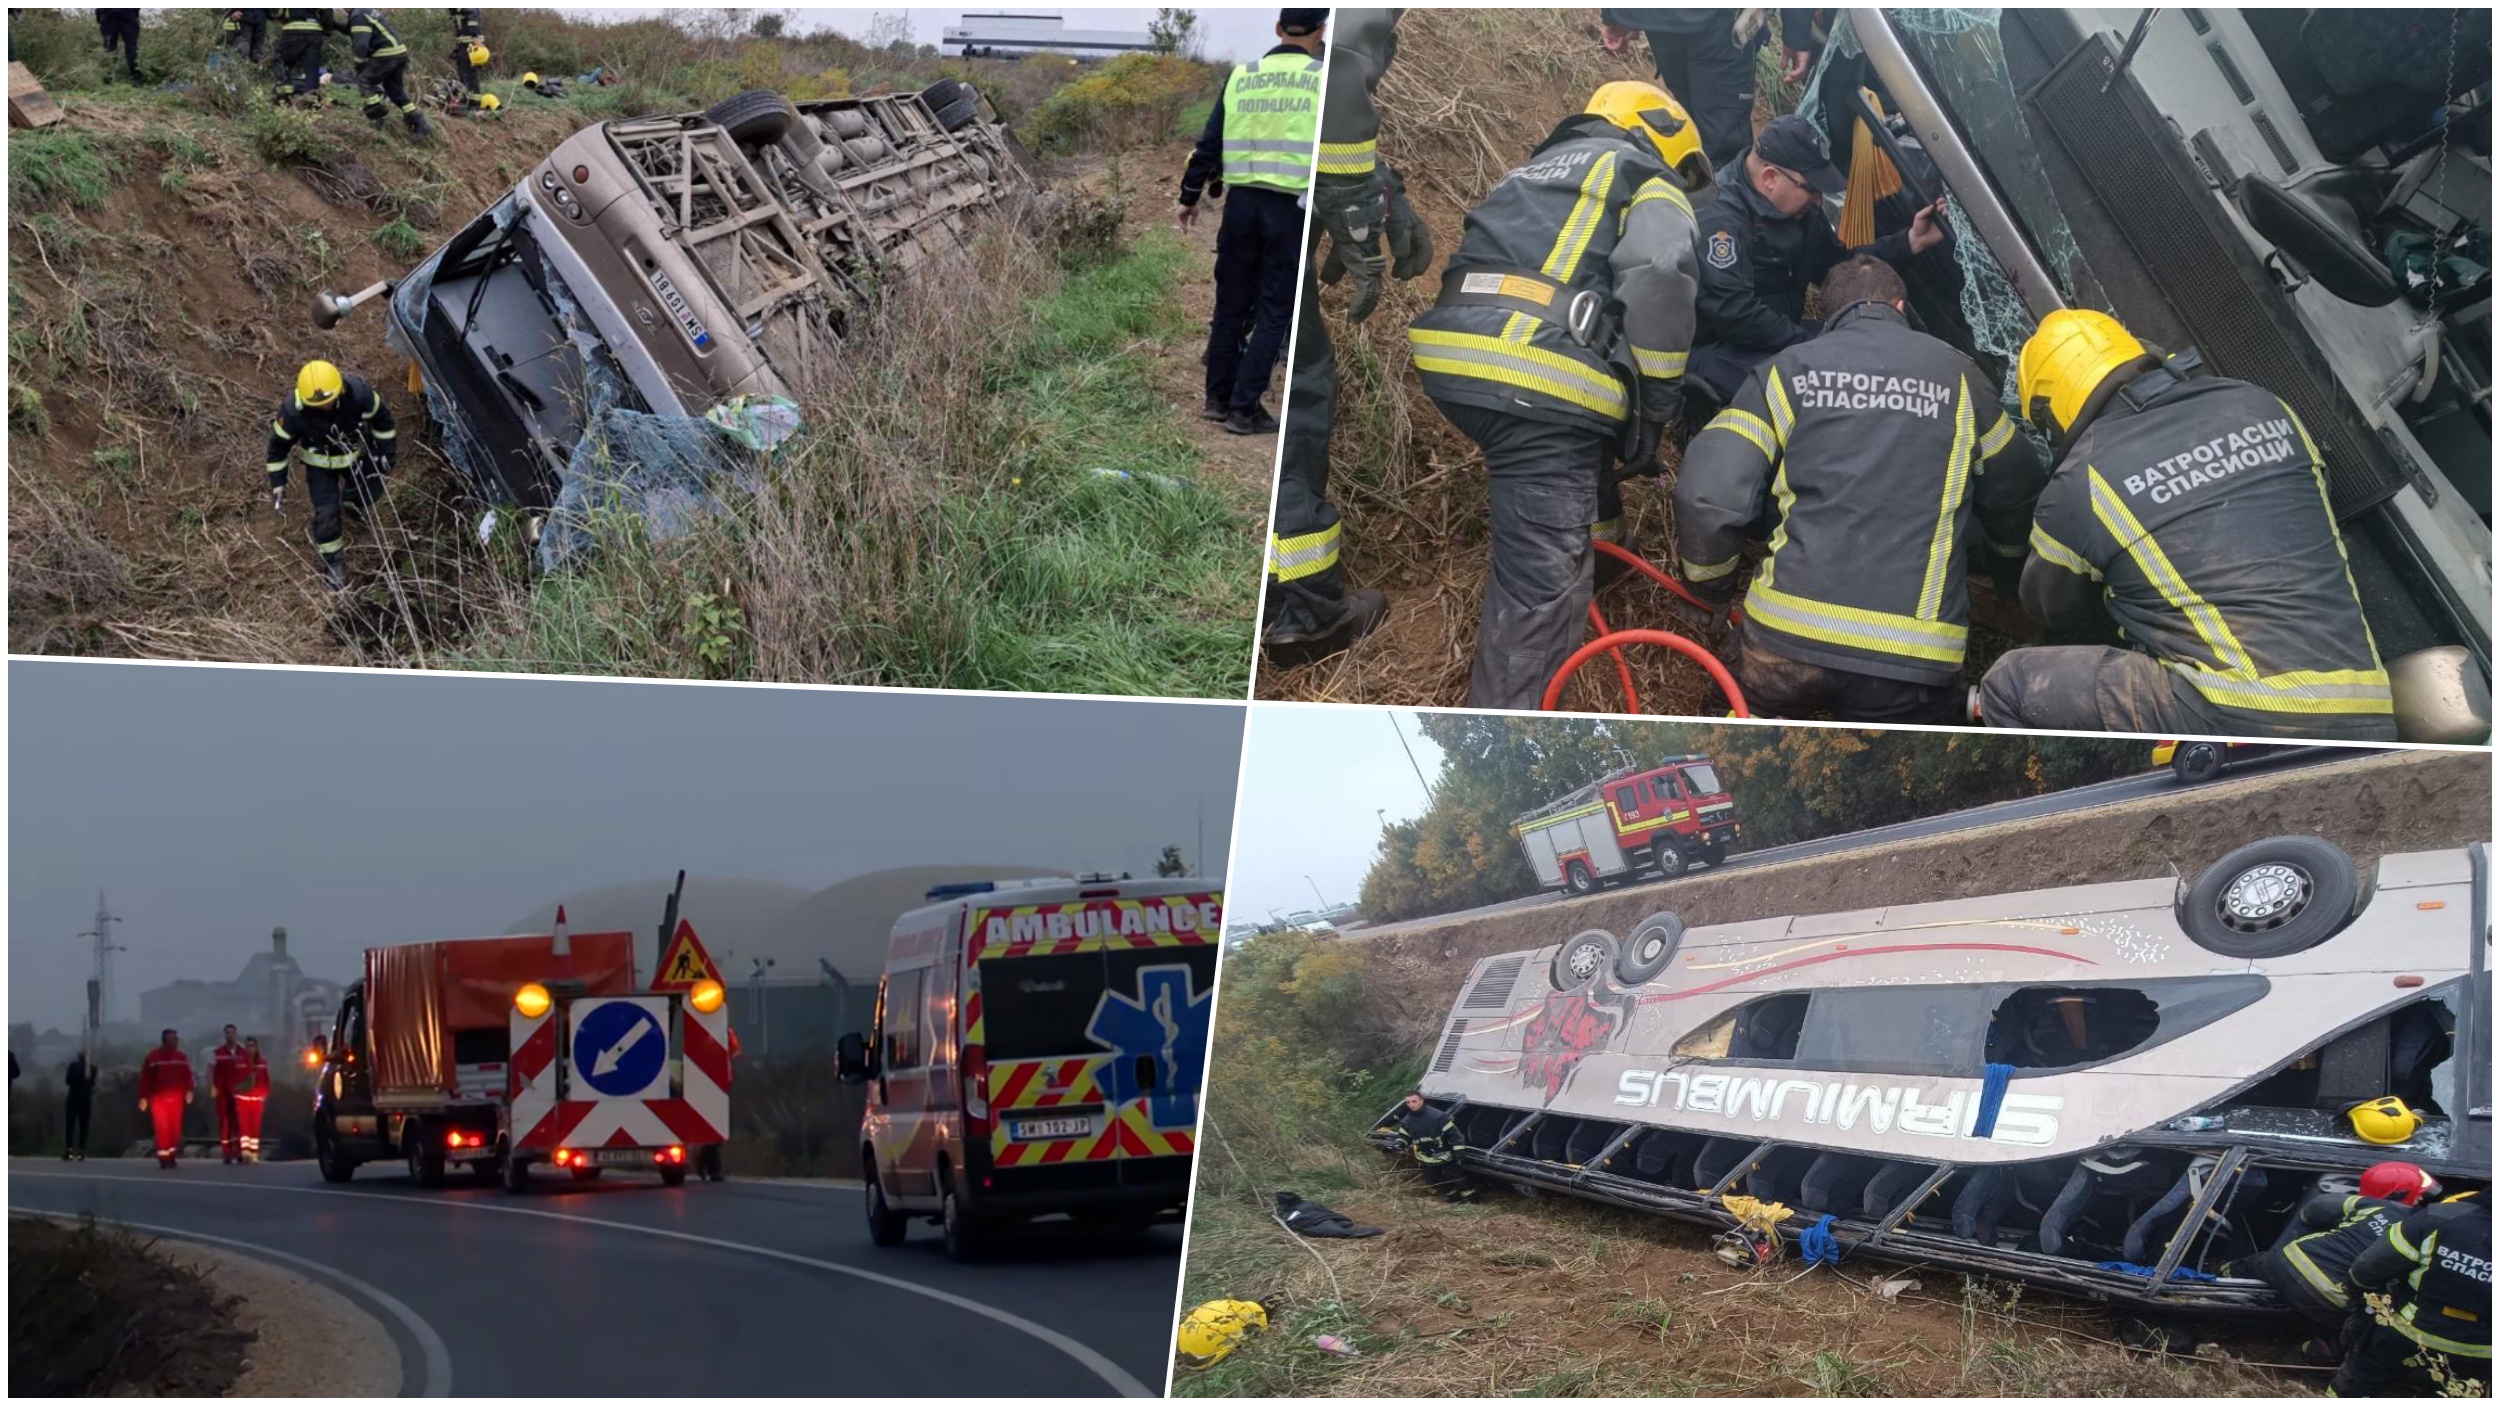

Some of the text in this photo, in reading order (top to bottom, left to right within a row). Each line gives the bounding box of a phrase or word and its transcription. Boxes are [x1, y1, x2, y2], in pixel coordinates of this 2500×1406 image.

[1235, 72, 1319, 93] САОБРАЋАЈНА
[1237, 98, 1311, 113] ПОЛИЦИЈА
[1792, 370, 1951, 405] ВАТРОГАСЦИ
[1802, 390, 1939, 419] СПАСИОЦИ
[2123, 418, 2294, 496] ВАТРОГАСЦИ
[2150, 438, 2295, 504] СПАСИОЦИ
[986, 902, 1219, 944] AMBULANCE
[1614, 1068, 2065, 1148] SIRMIUMBUS
